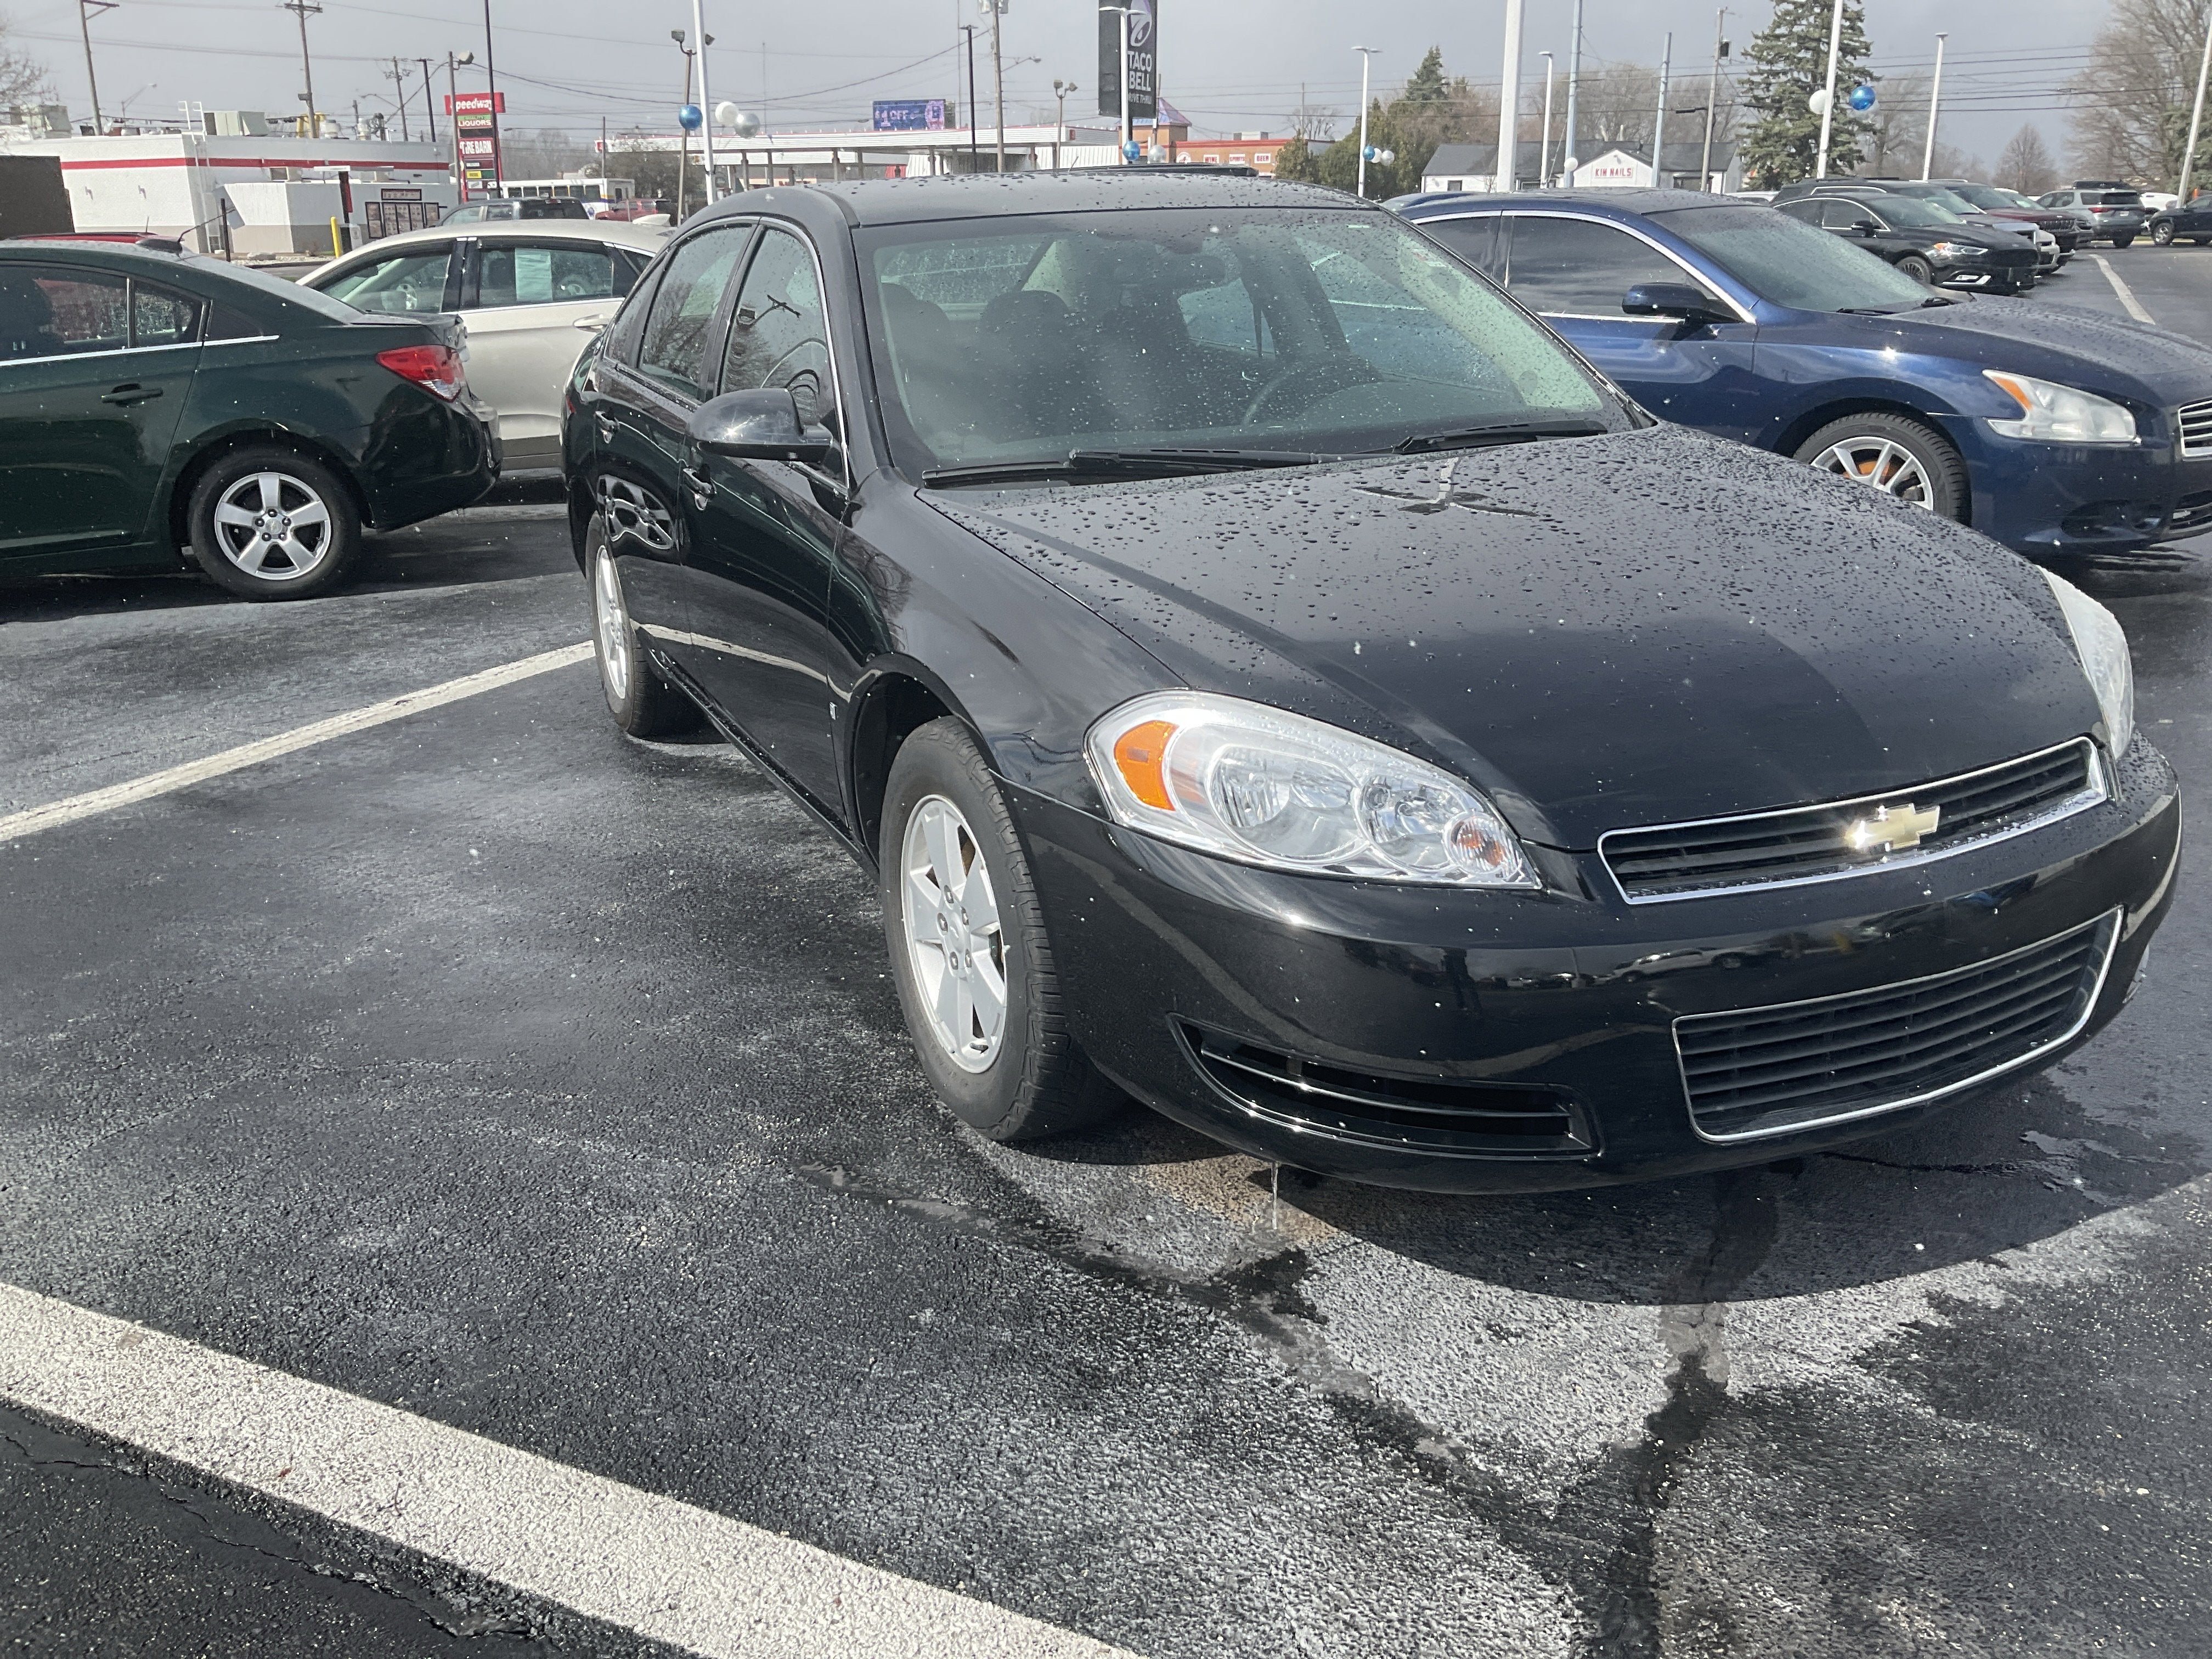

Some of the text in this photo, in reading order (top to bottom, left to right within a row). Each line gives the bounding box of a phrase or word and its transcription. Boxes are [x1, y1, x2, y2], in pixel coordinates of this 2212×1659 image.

[1127, 50, 1152, 72] TACO
[1128, 71, 1151, 91] BELL
[1128, 92, 1139, 103] RIVE
[450, 98, 492, 112] peedway
[890, 110, 909, 120] OFF
[475, 140, 493, 154] BARN
[1595, 167, 1632, 177] KIM NAILS
